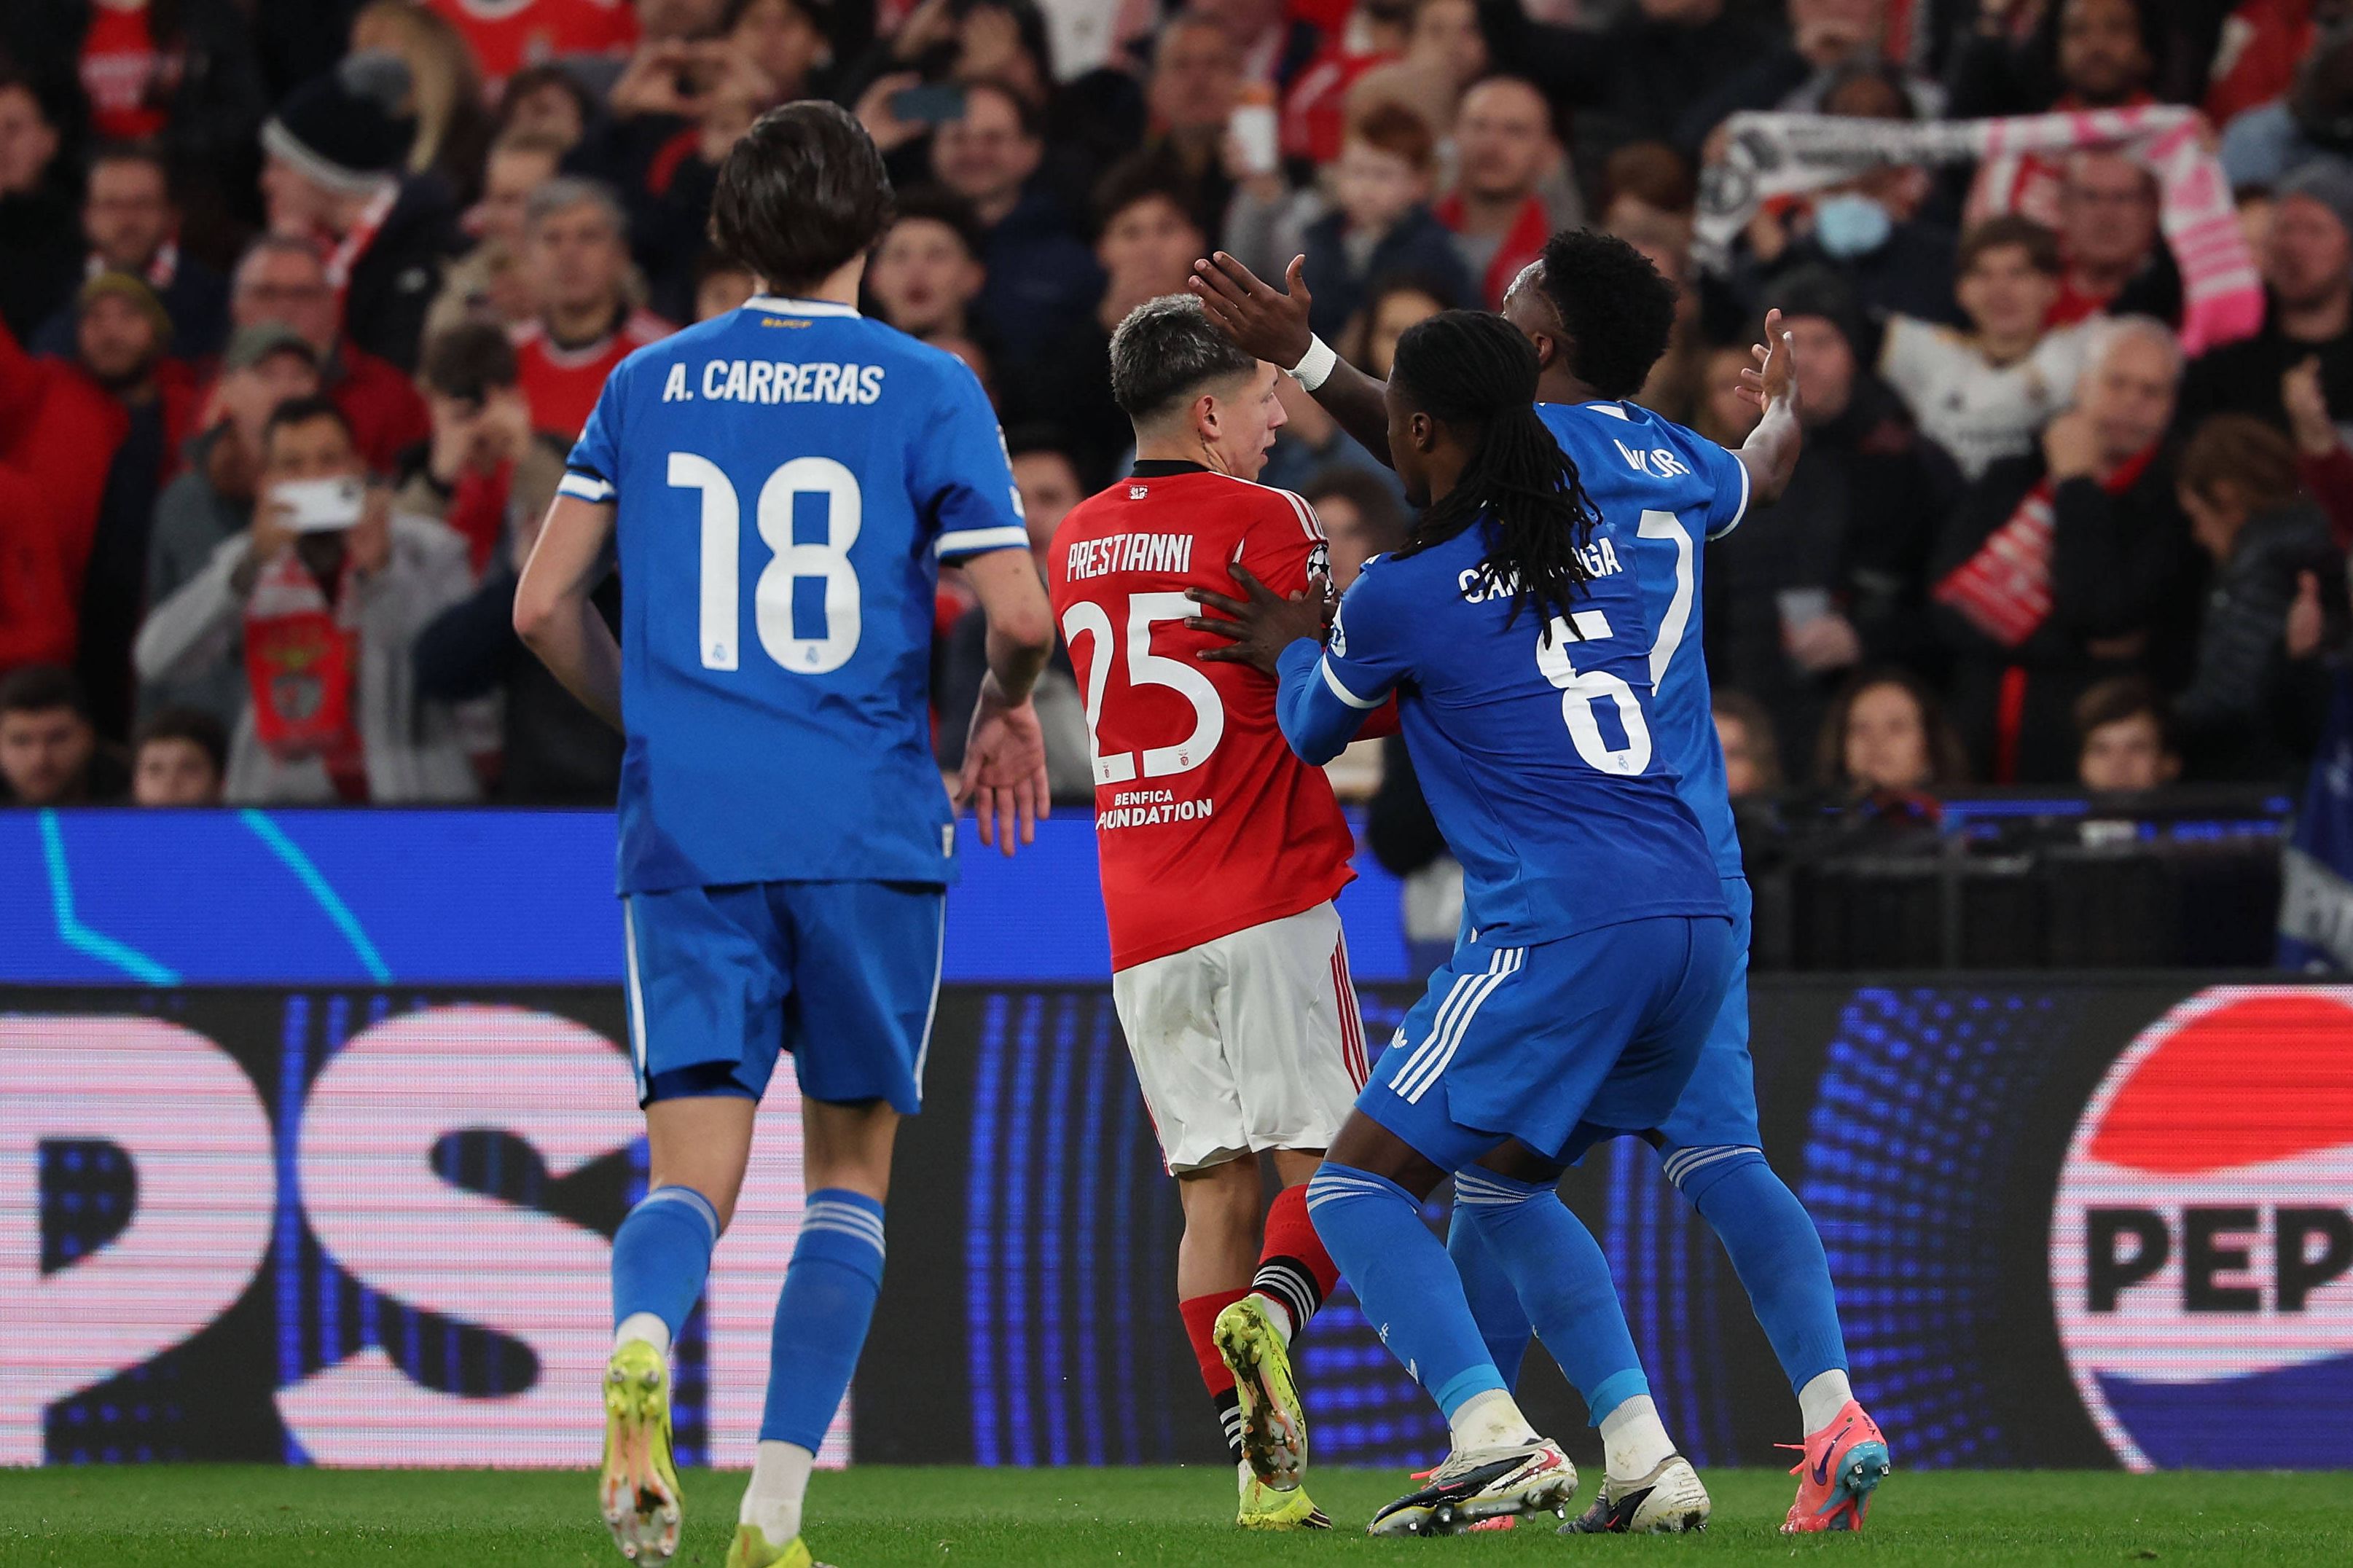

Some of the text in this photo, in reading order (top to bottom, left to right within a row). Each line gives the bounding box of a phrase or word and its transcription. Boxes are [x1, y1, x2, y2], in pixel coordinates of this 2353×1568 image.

[662, 359, 885, 405] A. CARRERAS
[666, 450, 863, 675] 18
[1066, 533, 1194, 583] PRESTIANNI
[1637, 509, 1694, 697] 7
[1062, 591, 1225, 786] 25
[1536, 610, 1653, 777] 6
[1095, 799, 1213, 831] UNDATION
[1114, 789, 1173, 807] BENFICA
[2087, 1207, 2353, 1312] PEP
